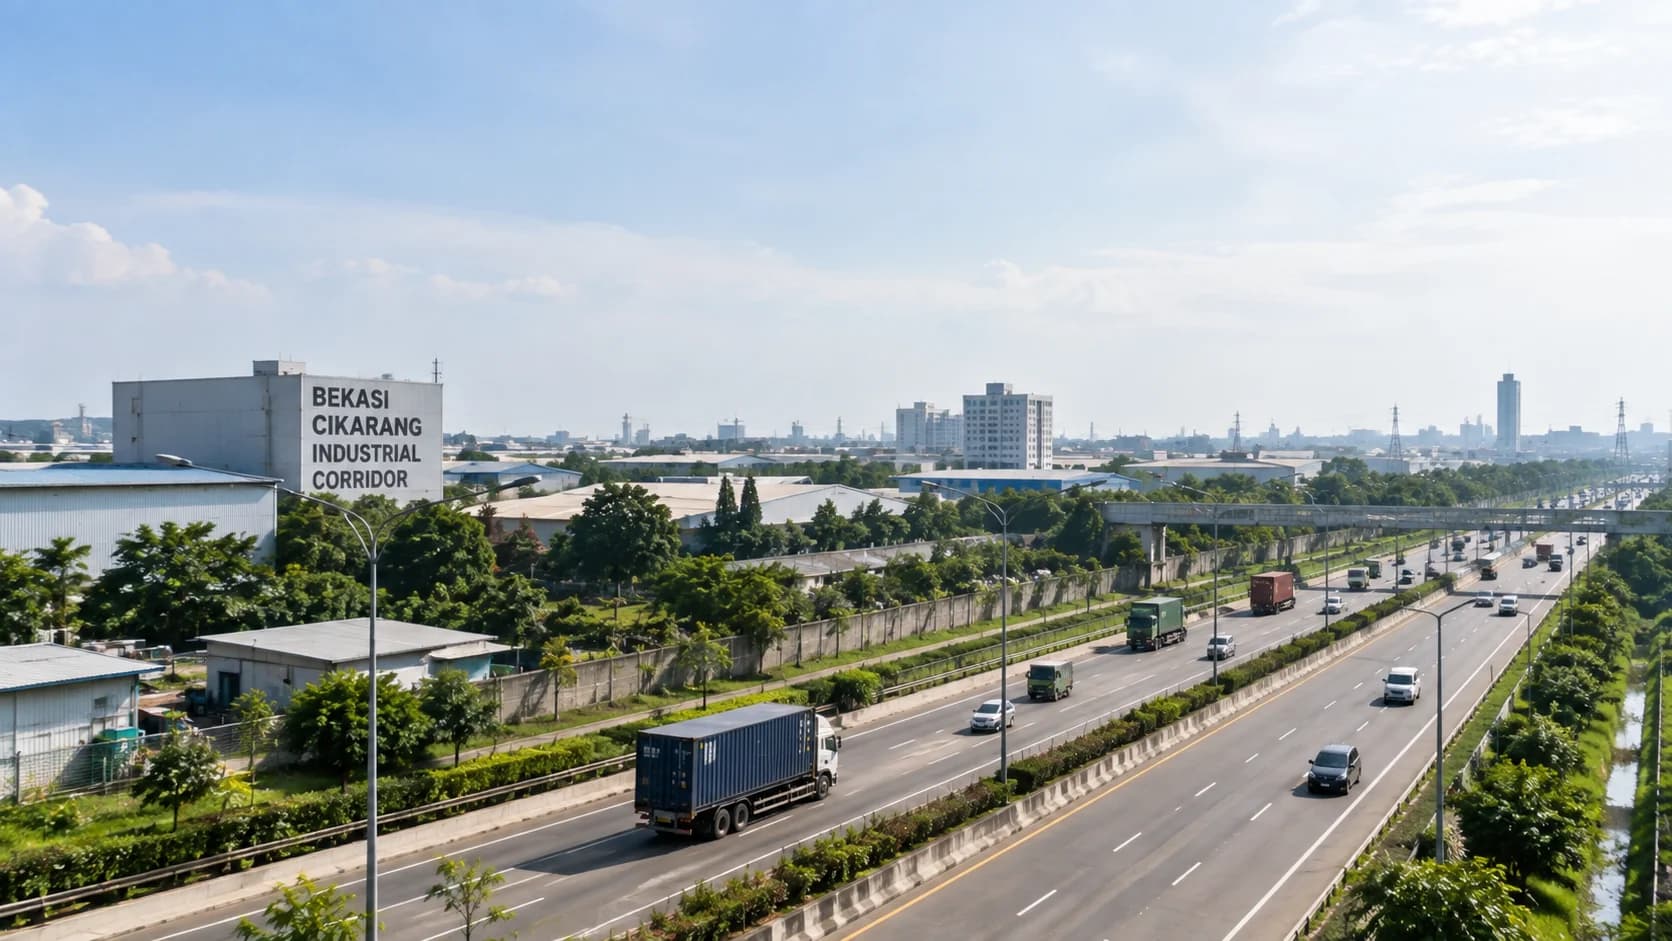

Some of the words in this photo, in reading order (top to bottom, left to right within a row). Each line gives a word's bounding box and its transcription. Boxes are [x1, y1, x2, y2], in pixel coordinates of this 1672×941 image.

[312, 385, 389, 410] BEKASI
[312, 414, 422, 437] CIKARANG
[312, 443, 422, 463] INDUSTRIAL
[312, 469, 408, 490] CORRIDOR
